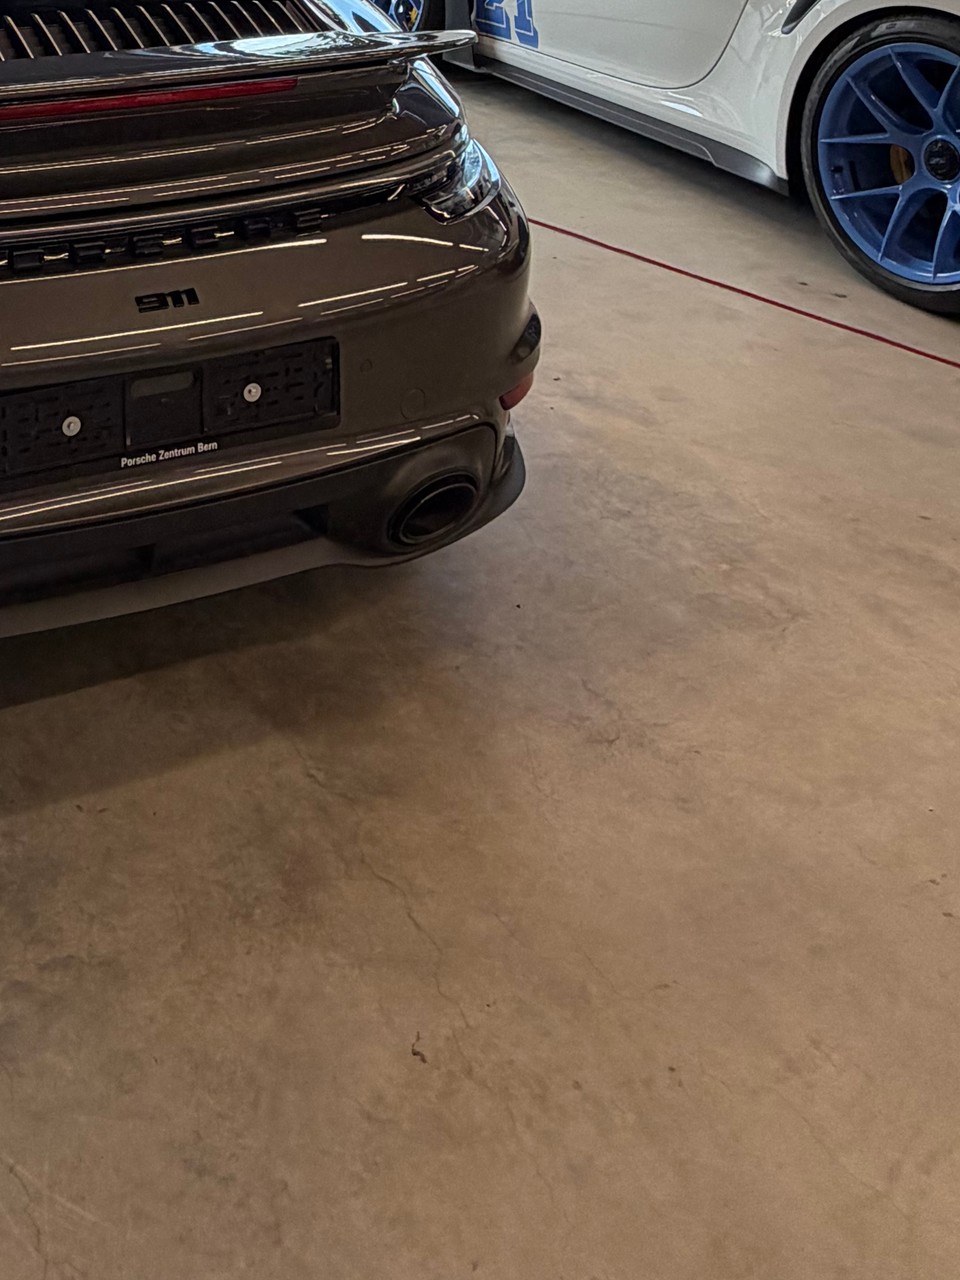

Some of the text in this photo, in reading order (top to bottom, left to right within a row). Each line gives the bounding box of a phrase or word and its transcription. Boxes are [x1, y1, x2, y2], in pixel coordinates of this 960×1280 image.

[134, 287, 200, 314] 911
[120, 441, 218, 468] Porsche Zentrum Bern
